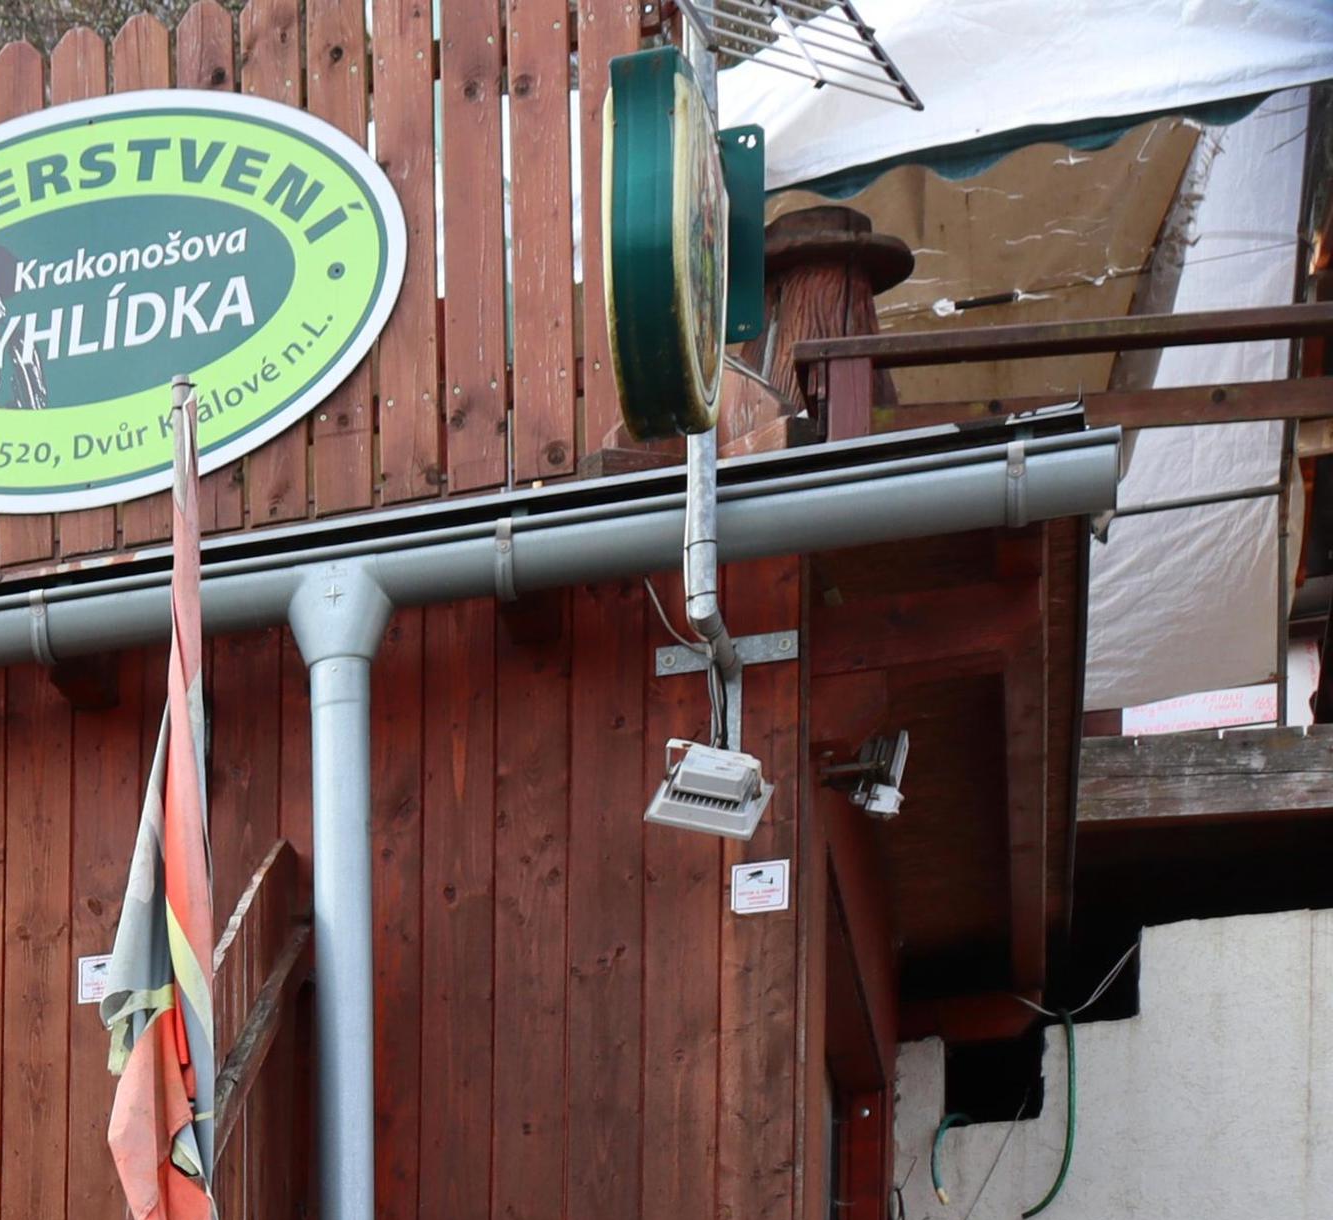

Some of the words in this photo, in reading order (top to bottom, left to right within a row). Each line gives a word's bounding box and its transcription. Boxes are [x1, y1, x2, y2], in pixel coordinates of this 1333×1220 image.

[14, 227, 247, 293] Krakonošova
[73, 422, 148, 460] Dvůr
[158, 356, 281, 439] Kálové
